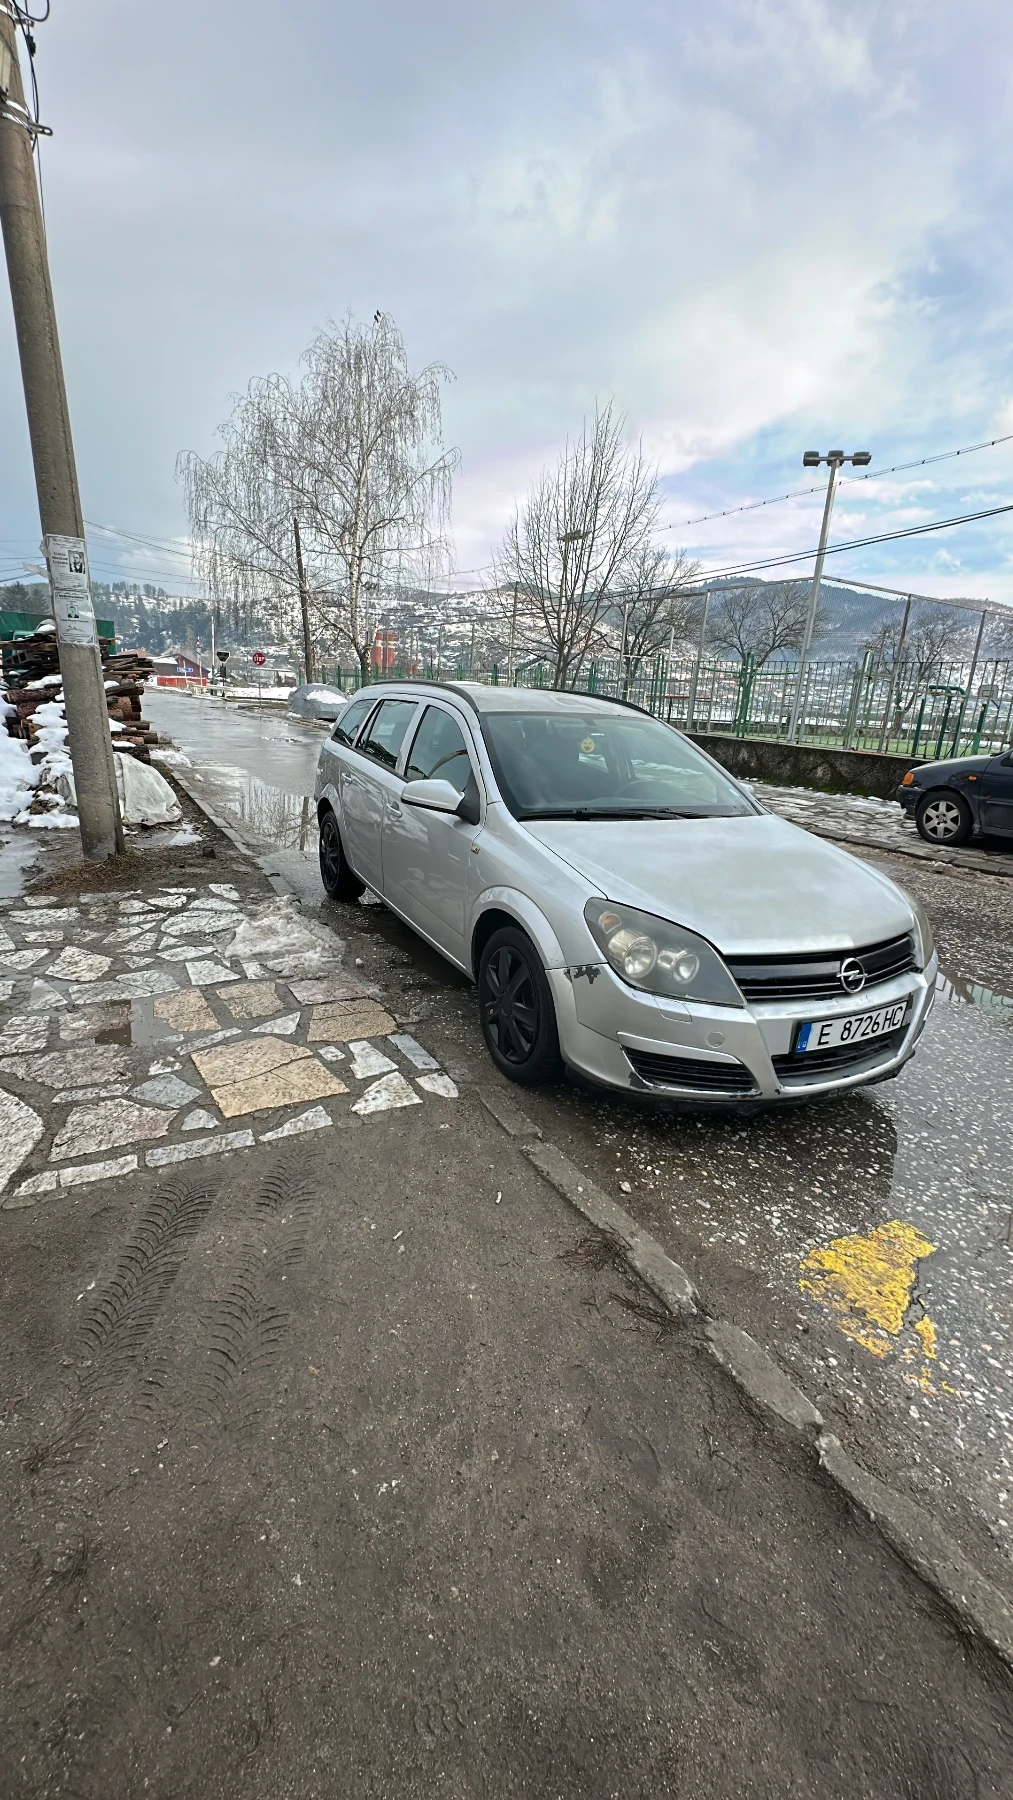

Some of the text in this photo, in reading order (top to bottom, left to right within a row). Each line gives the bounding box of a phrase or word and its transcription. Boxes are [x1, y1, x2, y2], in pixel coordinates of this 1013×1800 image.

[817, 1006, 903, 1046] E 8726 HC
